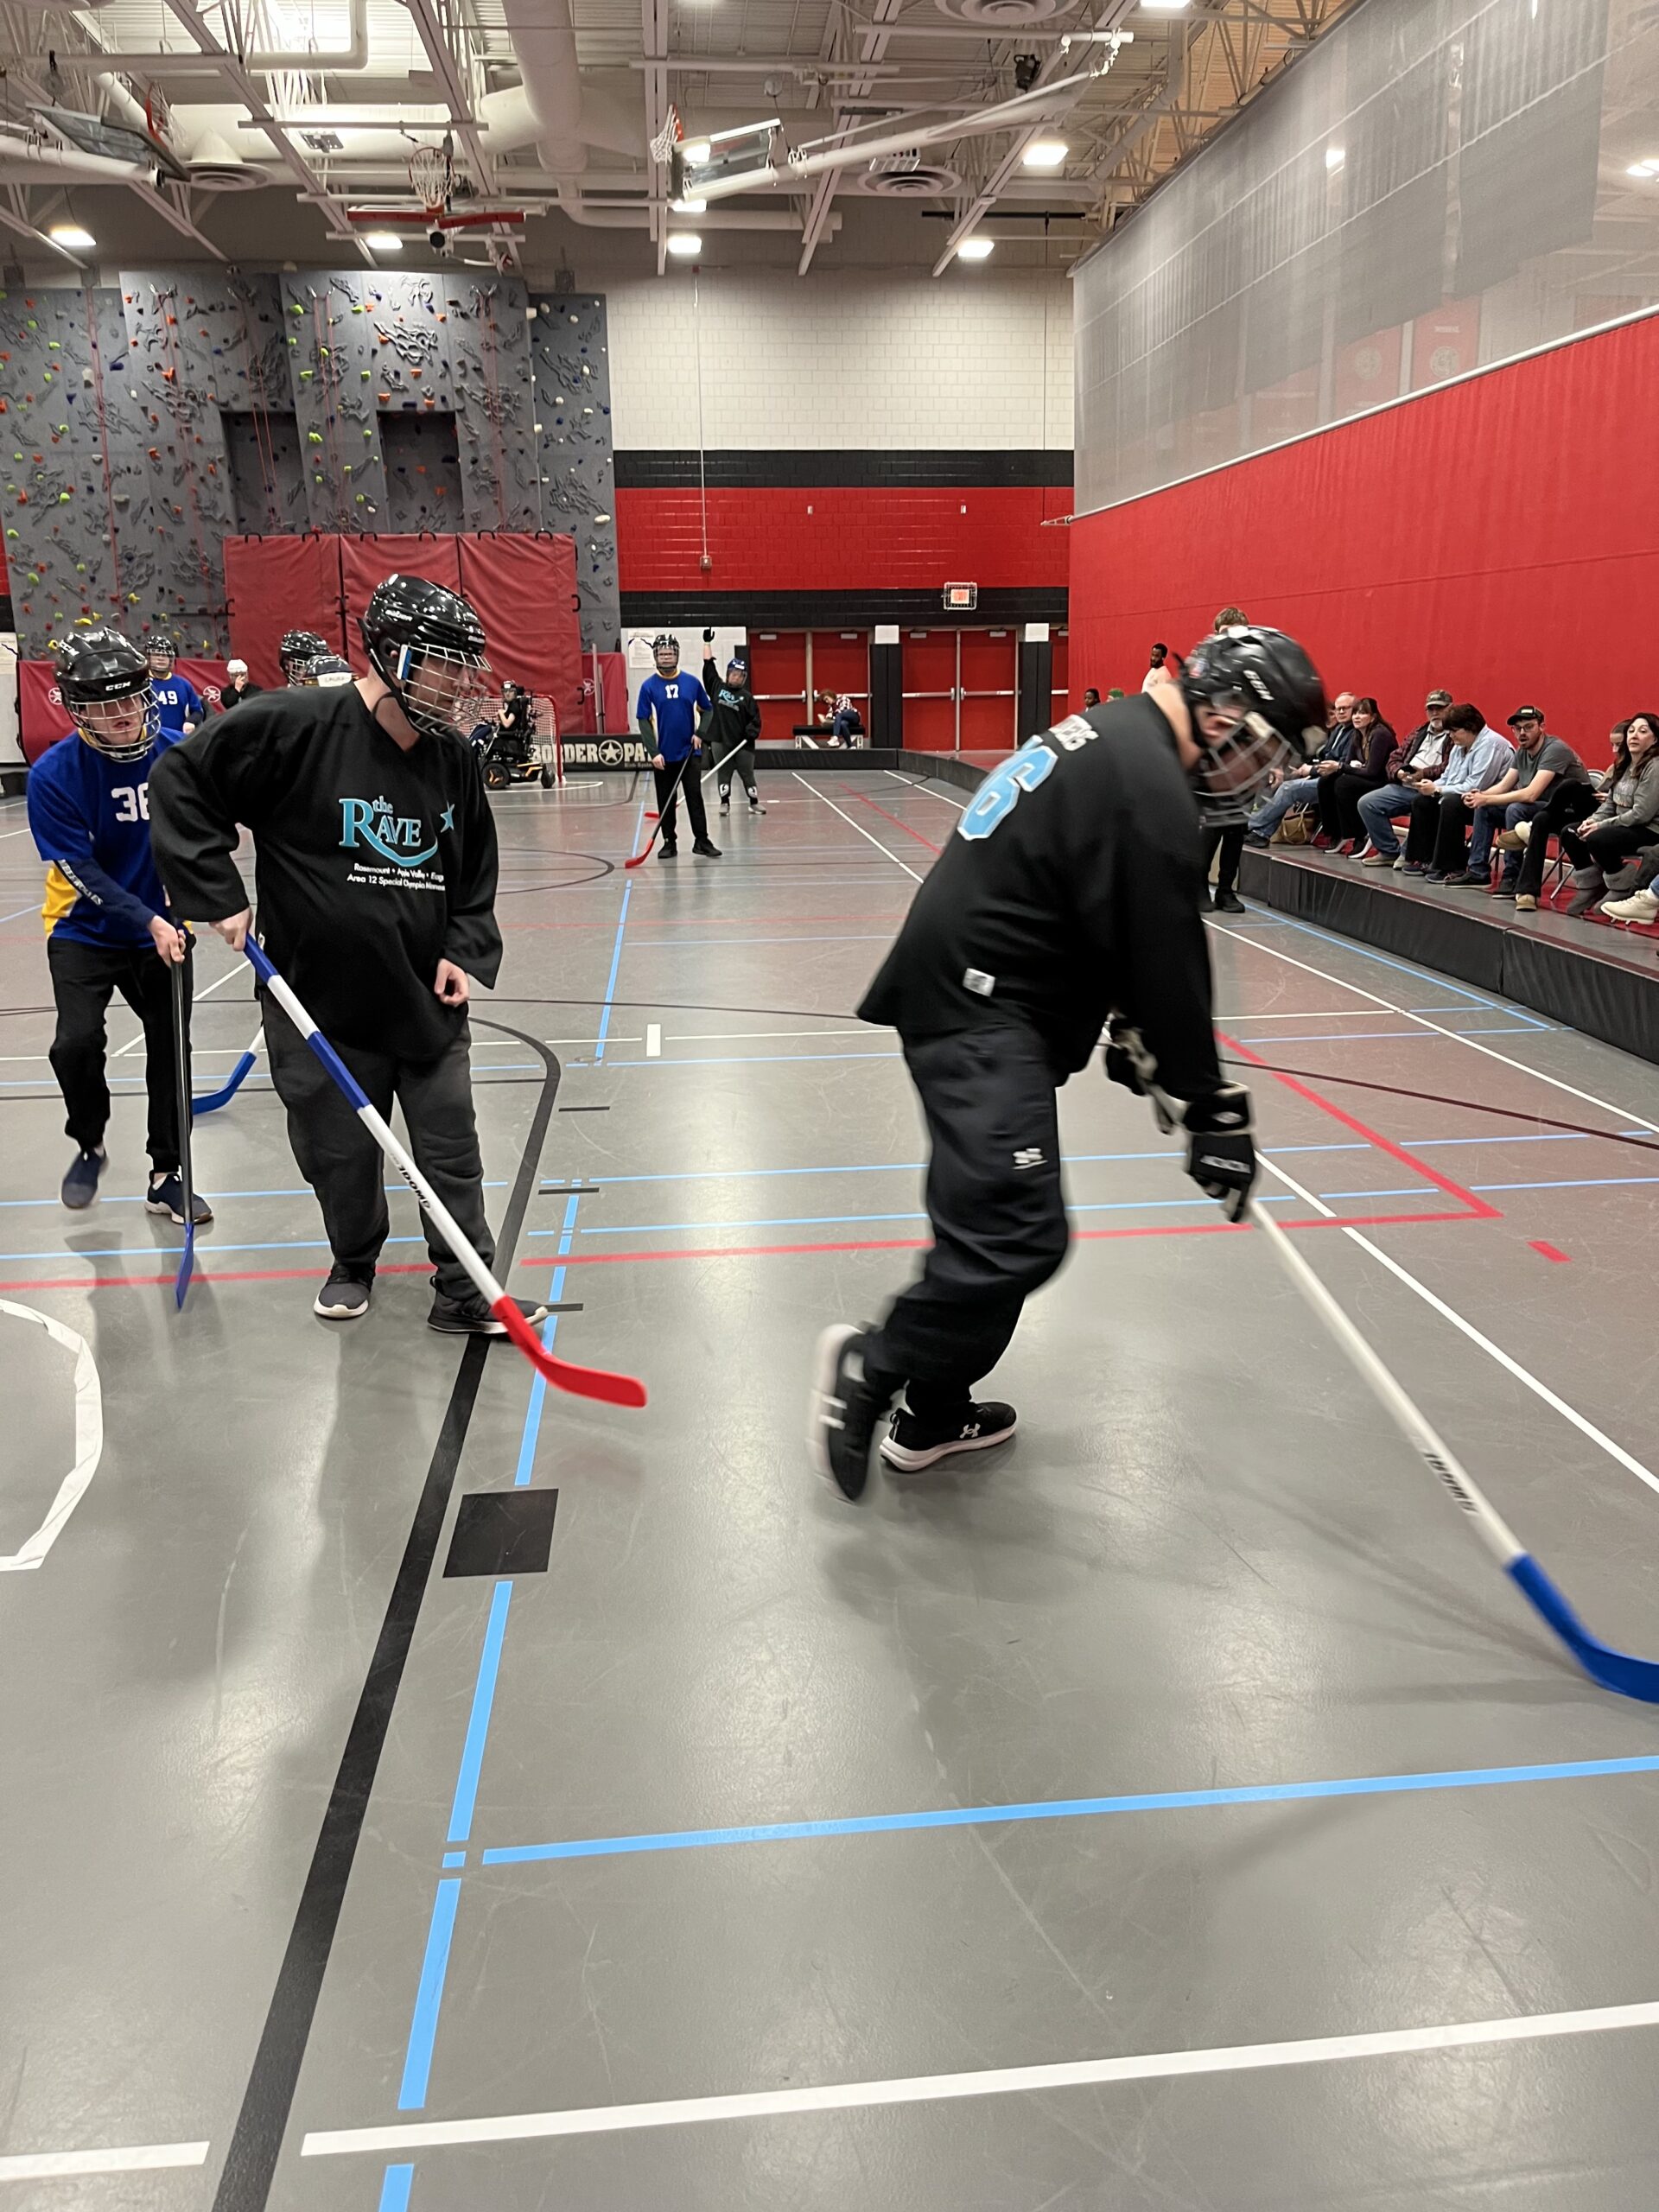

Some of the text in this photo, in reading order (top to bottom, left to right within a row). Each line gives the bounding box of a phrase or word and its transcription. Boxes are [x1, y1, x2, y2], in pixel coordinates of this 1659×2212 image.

[105, 681, 131, 691] CCM
[664, 683, 679, 699] 17
[158, 690, 178, 705] 49
[372, 796, 394, 814] the
[353, 862, 391, 874] Rosemount
[346, 874, 366, 883] Area
[368, 874, 378, 885] 12
[378, 876, 403, 887] Special
